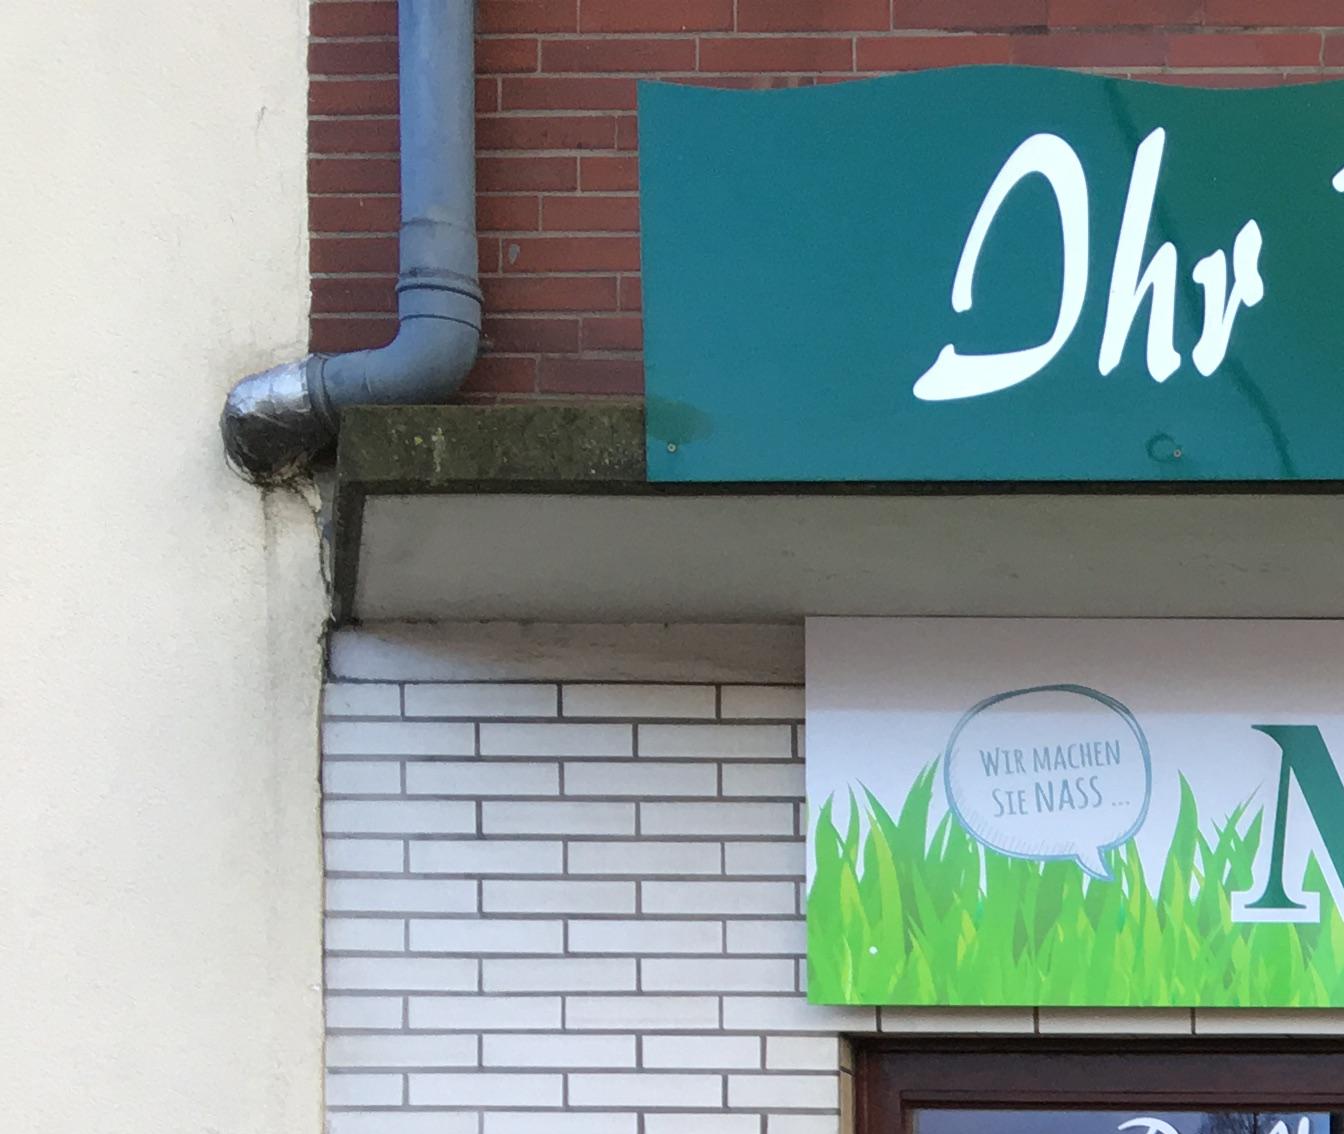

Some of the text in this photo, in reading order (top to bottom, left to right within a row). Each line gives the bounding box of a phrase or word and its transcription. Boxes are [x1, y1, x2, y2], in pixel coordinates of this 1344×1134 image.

[914, 128, 1264, 401] Ihr
[979, 739, 1121, 777] WIR MACHEN
[992, 786, 1029, 817] SIE
[1035, 775, 1103, 813] NASS
